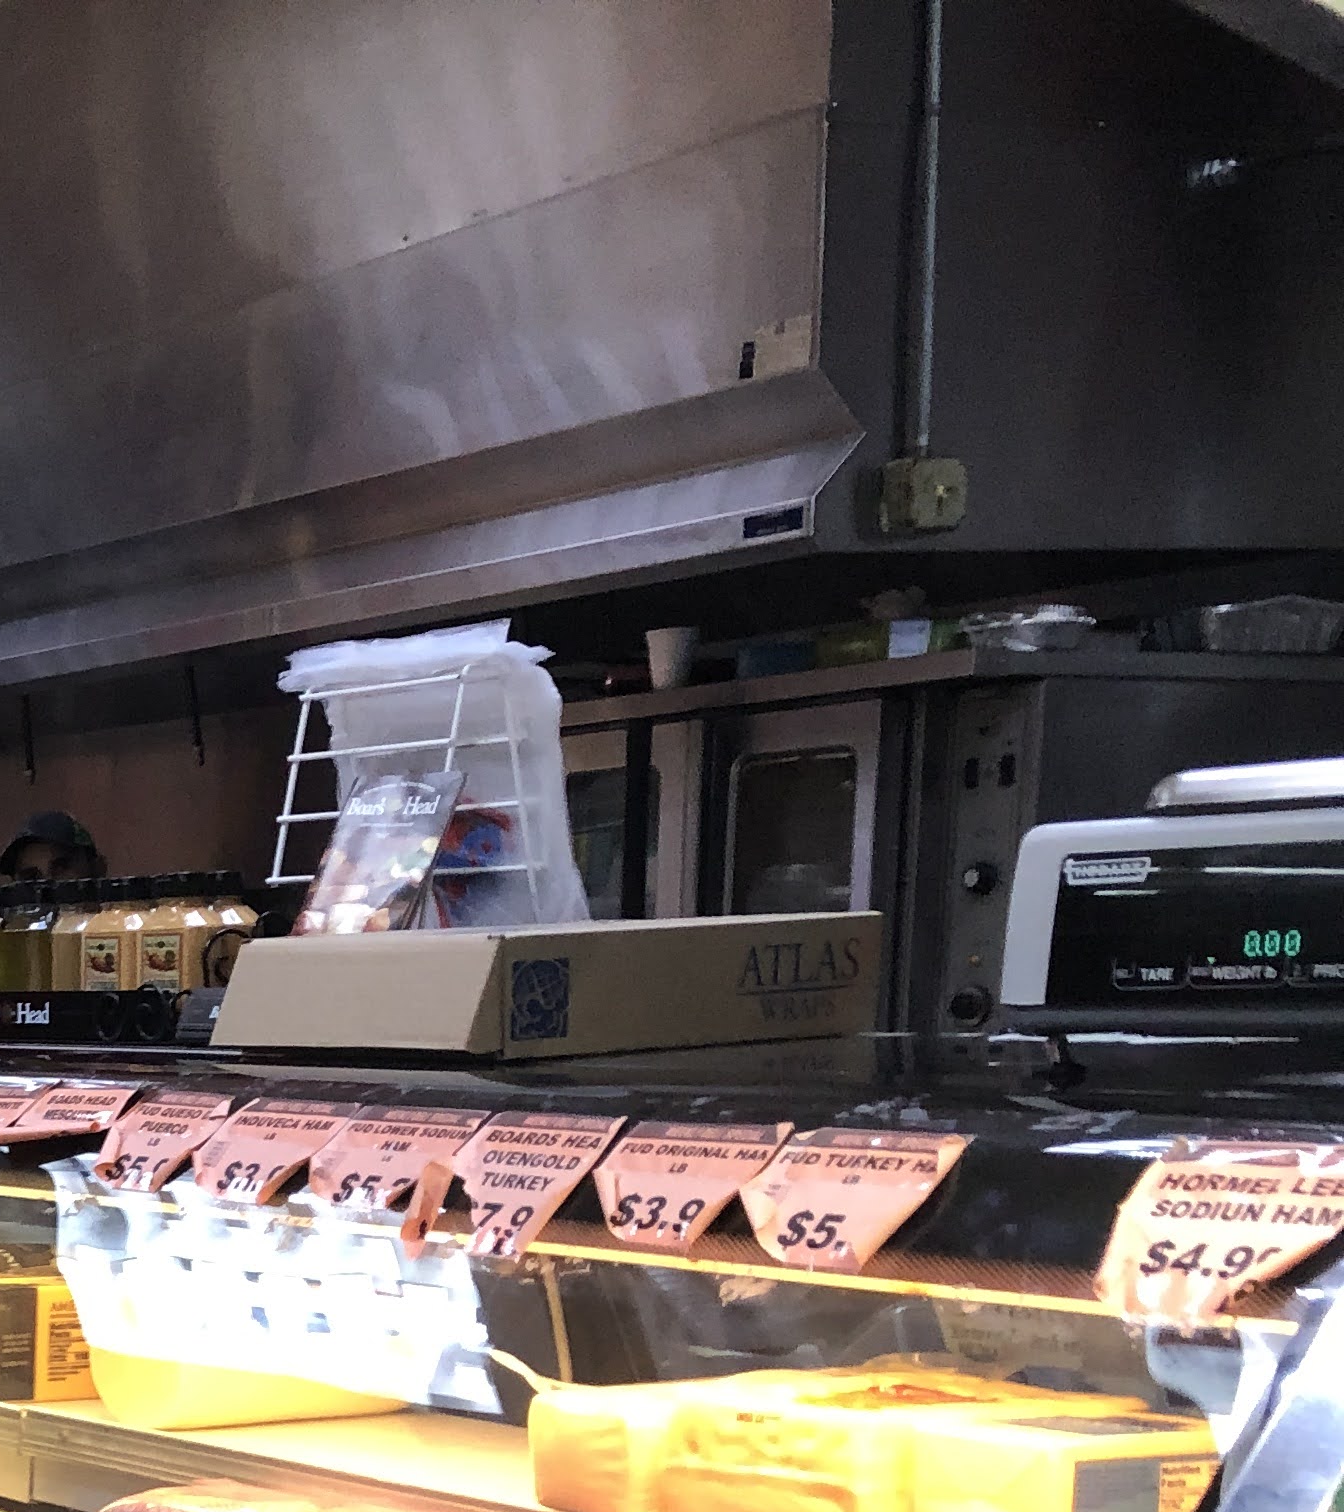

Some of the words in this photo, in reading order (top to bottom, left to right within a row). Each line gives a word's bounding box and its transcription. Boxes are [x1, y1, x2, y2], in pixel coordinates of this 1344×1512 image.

[347, 797, 386, 815] Boar's
[403, 795, 441, 815] Head
[736, 937, 861, 986] ATLAS
[15, 1002, 50, 1024] Head
[162, 1108, 202, 1119] QUESO
[234, 1115, 300, 1129] INDUVECA
[304, 1119, 335, 1131] HAM
[139, 1121, 189, 1134] PUERCO
[373, 1124, 417, 1137] LOWER
[419, 1128, 474, 1140] SODIUM
[486, 1129, 559, 1146] BOARDS
[560, 1134, 603, 1150] HEA
[482, 1150, 581, 1171] OVENGOLD
[621, 1143, 652, 1156] FUD
[653, 1144, 729, 1159] ORIGINAL
[779, 1152, 823, 1166] FUD
[826, 1153, 910, 1172] TURKEY
[913, 1158, 939, 1174] HA
[481, 1171, 554, 1192] TURKEY
[1159, 1173, 1282, 1195] HORMEL
[610, 1193, 706, 1233] $3.9
[1270, 1204, 1344, 1227] HAM
